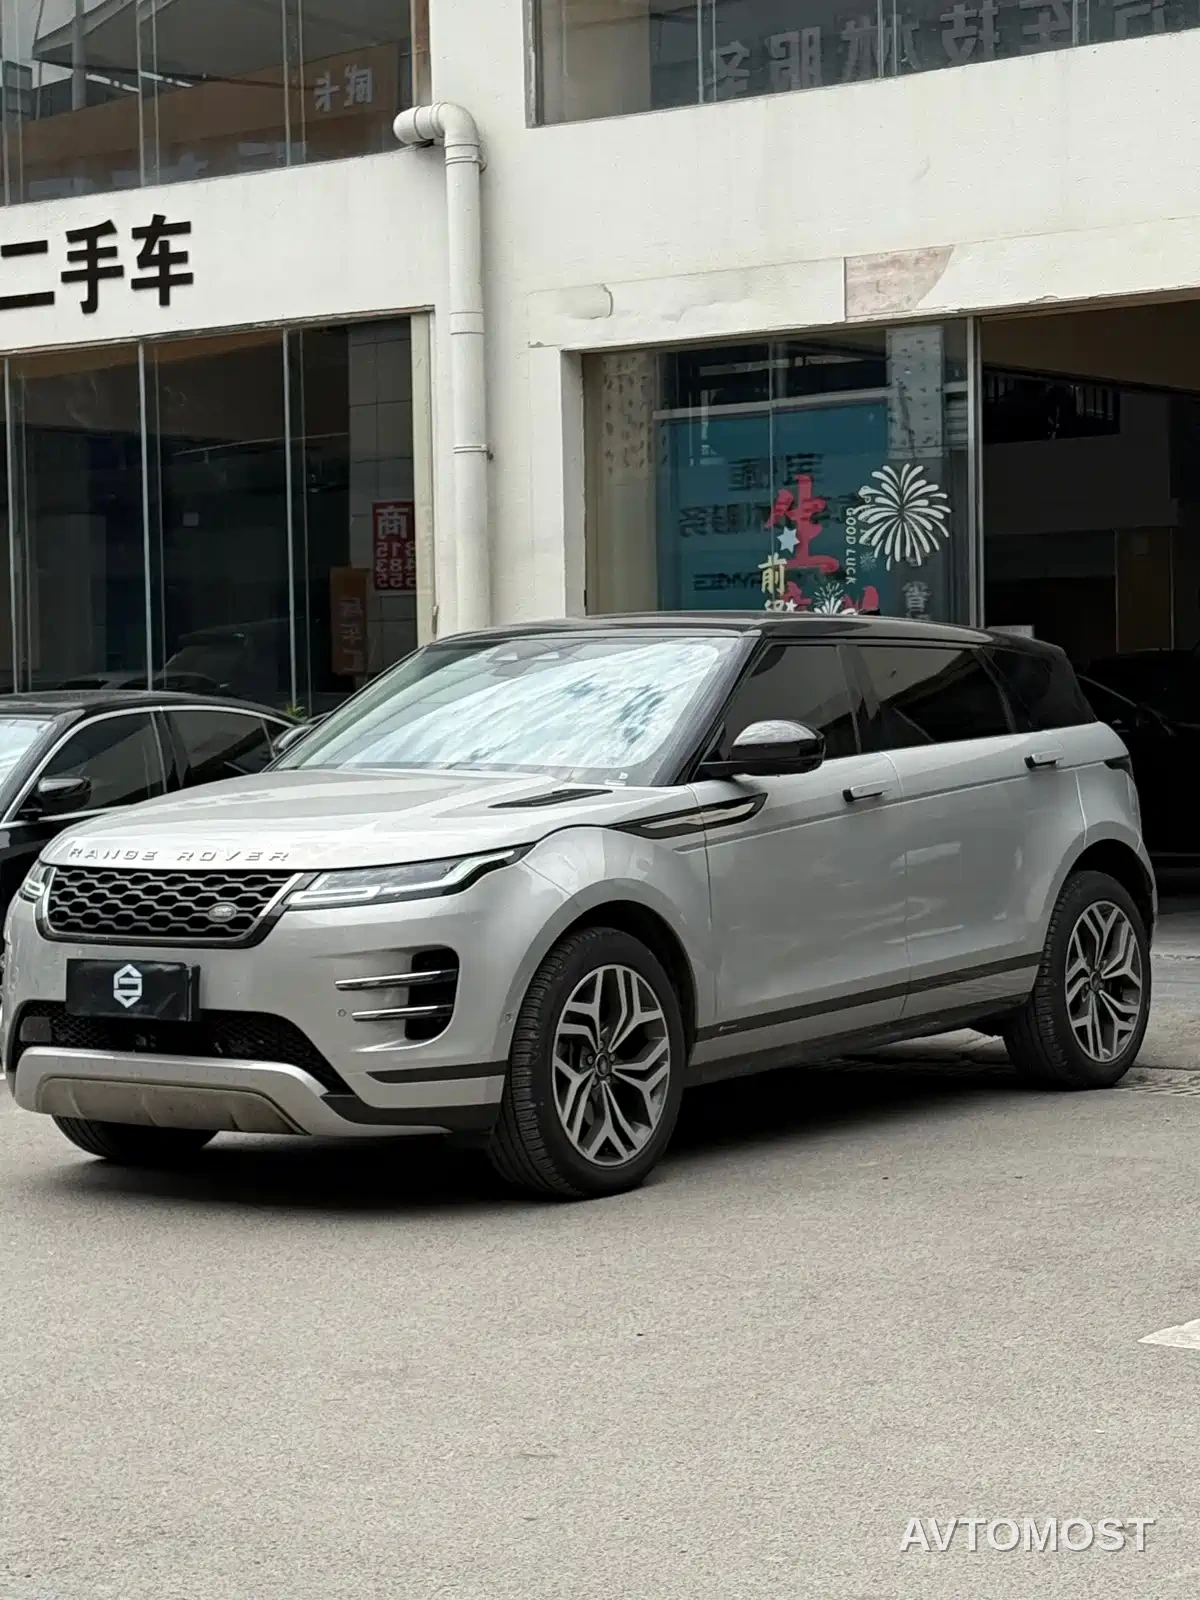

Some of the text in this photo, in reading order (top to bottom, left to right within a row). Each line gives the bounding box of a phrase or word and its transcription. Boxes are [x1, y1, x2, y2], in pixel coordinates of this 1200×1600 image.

[0, 214, 194, 314] 二手车
[845, 507, 857, 585] GOOD LUCK
[68, 846, 291, 862] RANGE ROVER
